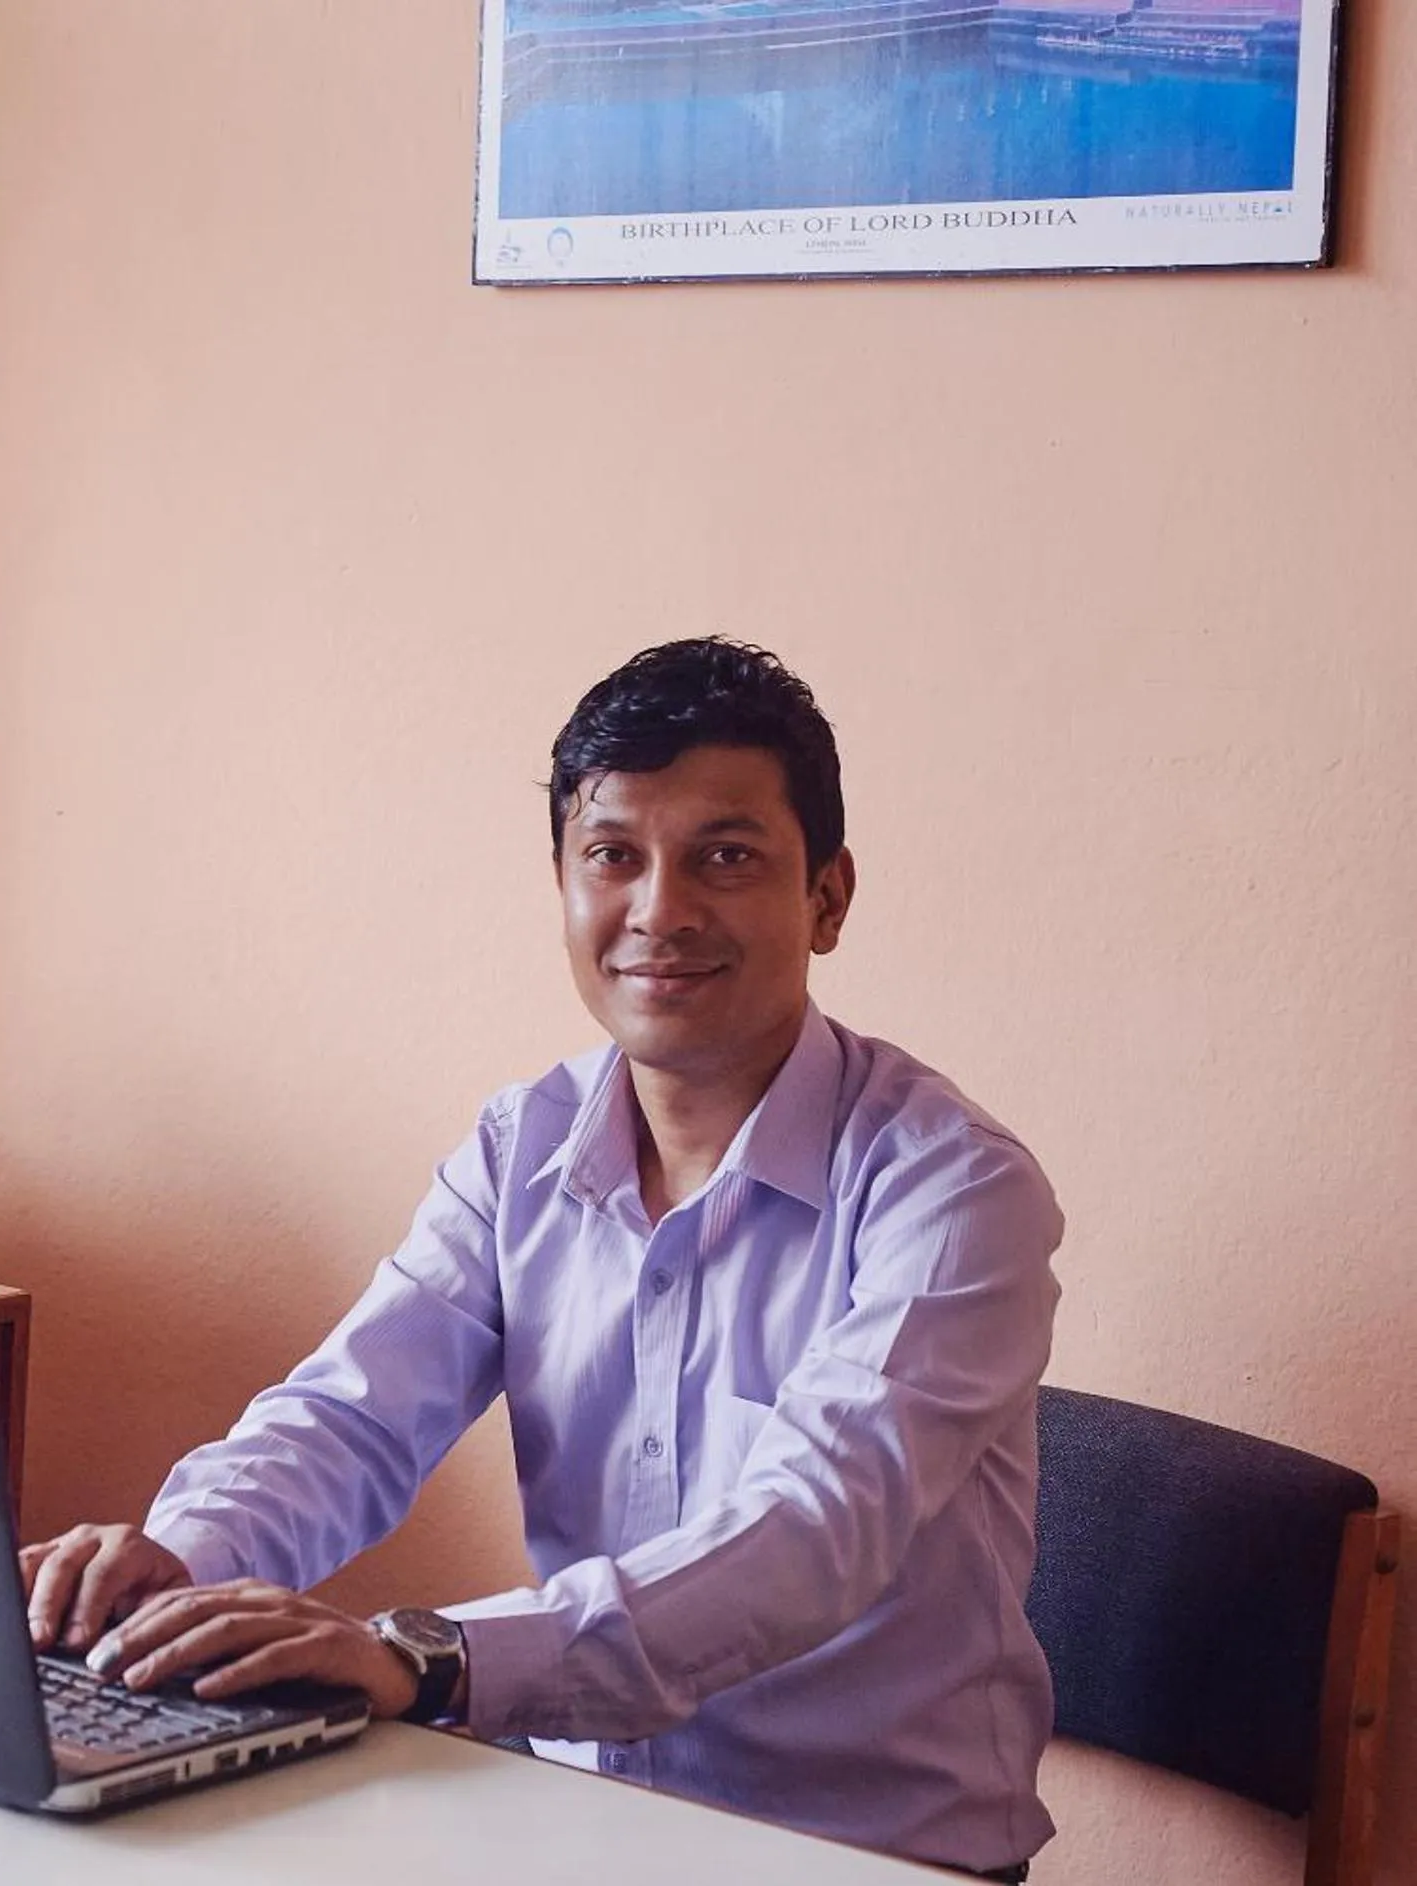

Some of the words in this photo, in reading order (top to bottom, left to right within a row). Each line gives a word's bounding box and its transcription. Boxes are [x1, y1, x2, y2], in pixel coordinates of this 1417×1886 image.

[621, 218, 795, 239] BIRTHPLACE
[803, 216, 842, 234] OF
[850, 214, 933, 232] LORD
[942, 208, 1078, 229] BUDDHA
